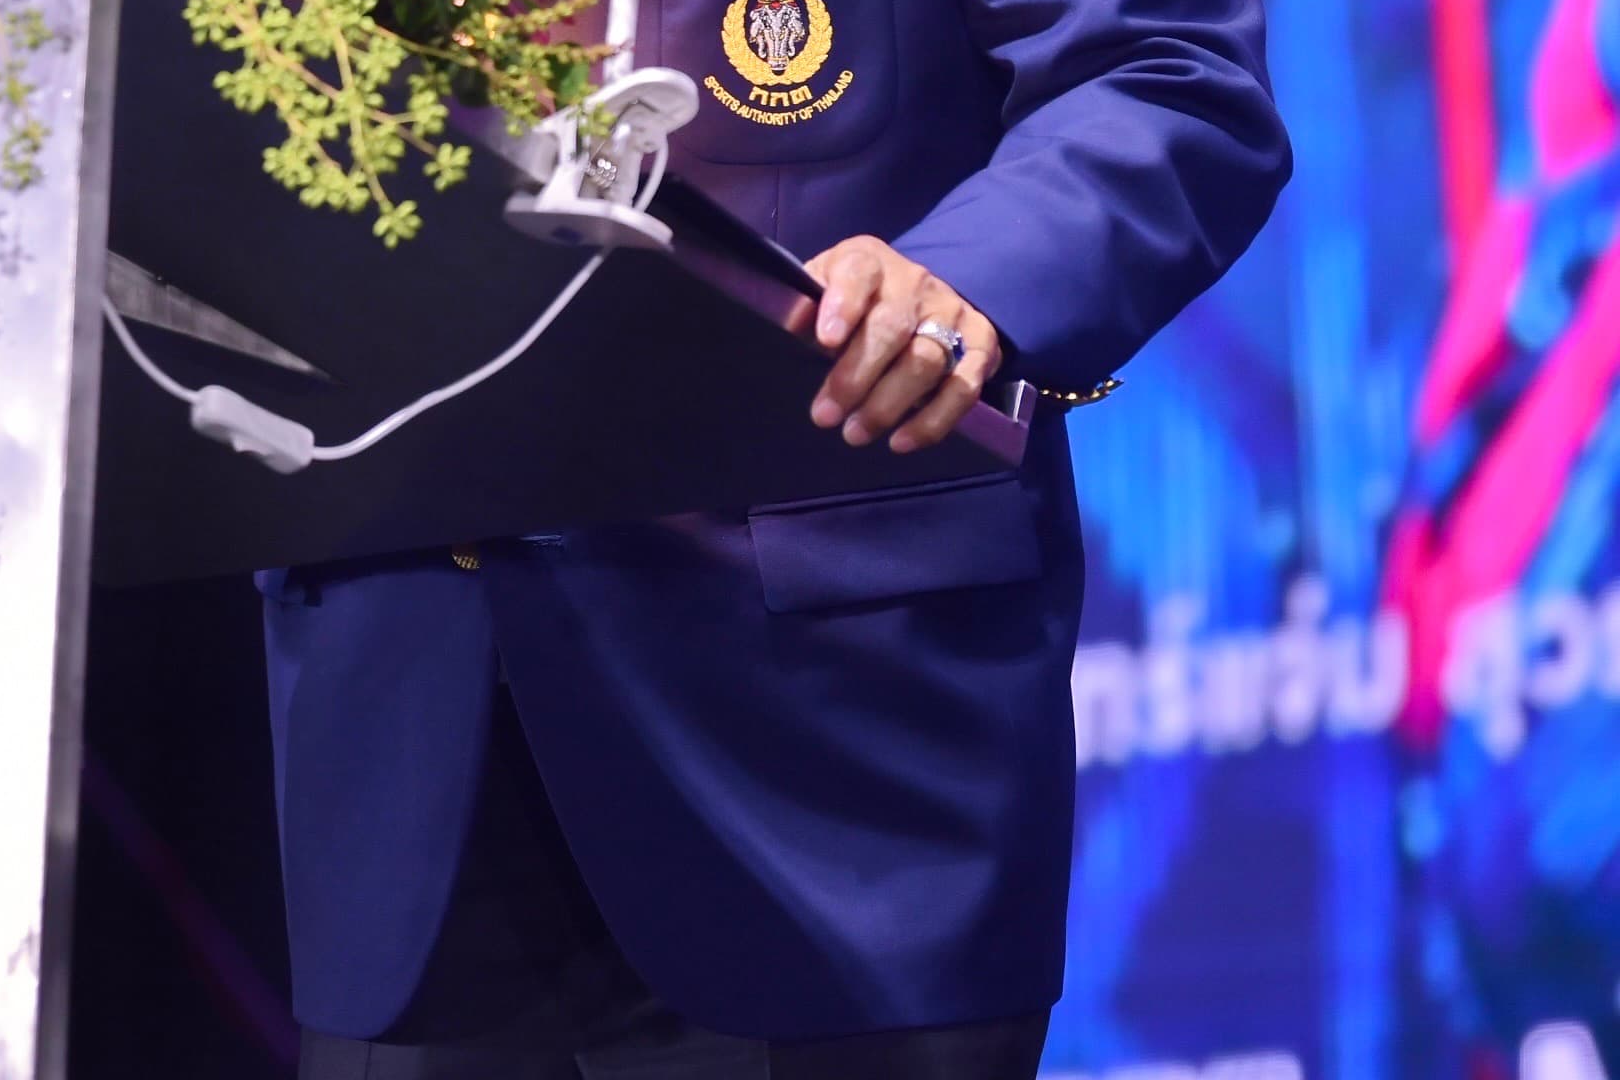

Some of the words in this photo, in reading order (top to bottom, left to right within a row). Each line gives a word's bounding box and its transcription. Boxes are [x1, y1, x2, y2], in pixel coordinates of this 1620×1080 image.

[703, 75, 741, 112] SPORTS
[735, 104, 798, 126] AUTHORITY
[797, 105, 814, 121] OF
[813, 69, 854, 113] THAILAND
